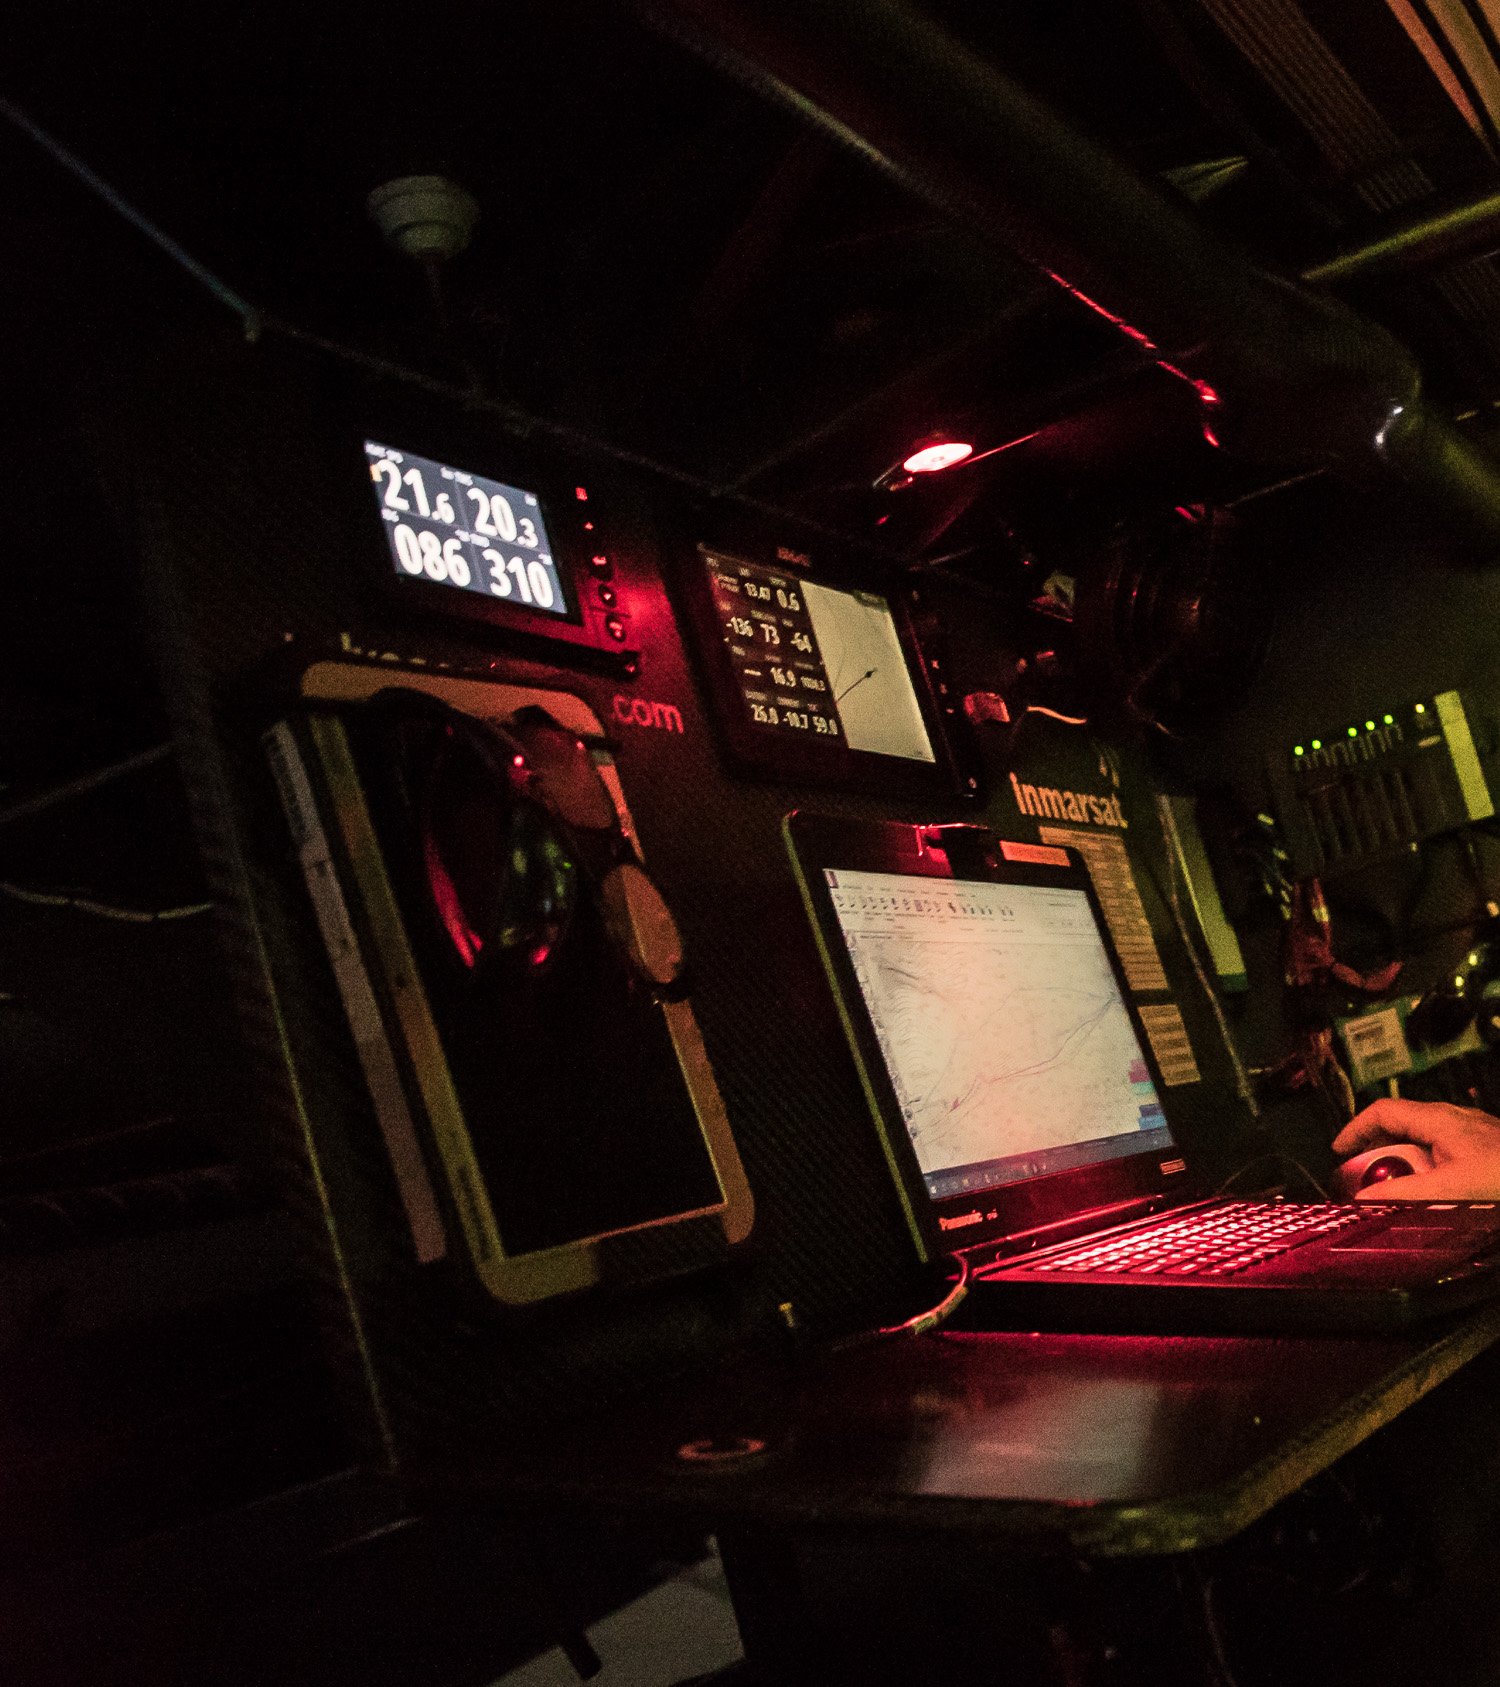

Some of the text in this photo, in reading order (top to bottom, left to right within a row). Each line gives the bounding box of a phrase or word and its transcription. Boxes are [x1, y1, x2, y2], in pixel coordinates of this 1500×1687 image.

[376, 458, 455, 524] 21.6
[467, 487, 539, 548] 20.3
[394, 524, 471, 587] 086
[482, 549, 554, 608] 310
[759, 623, 780, 645] 73
